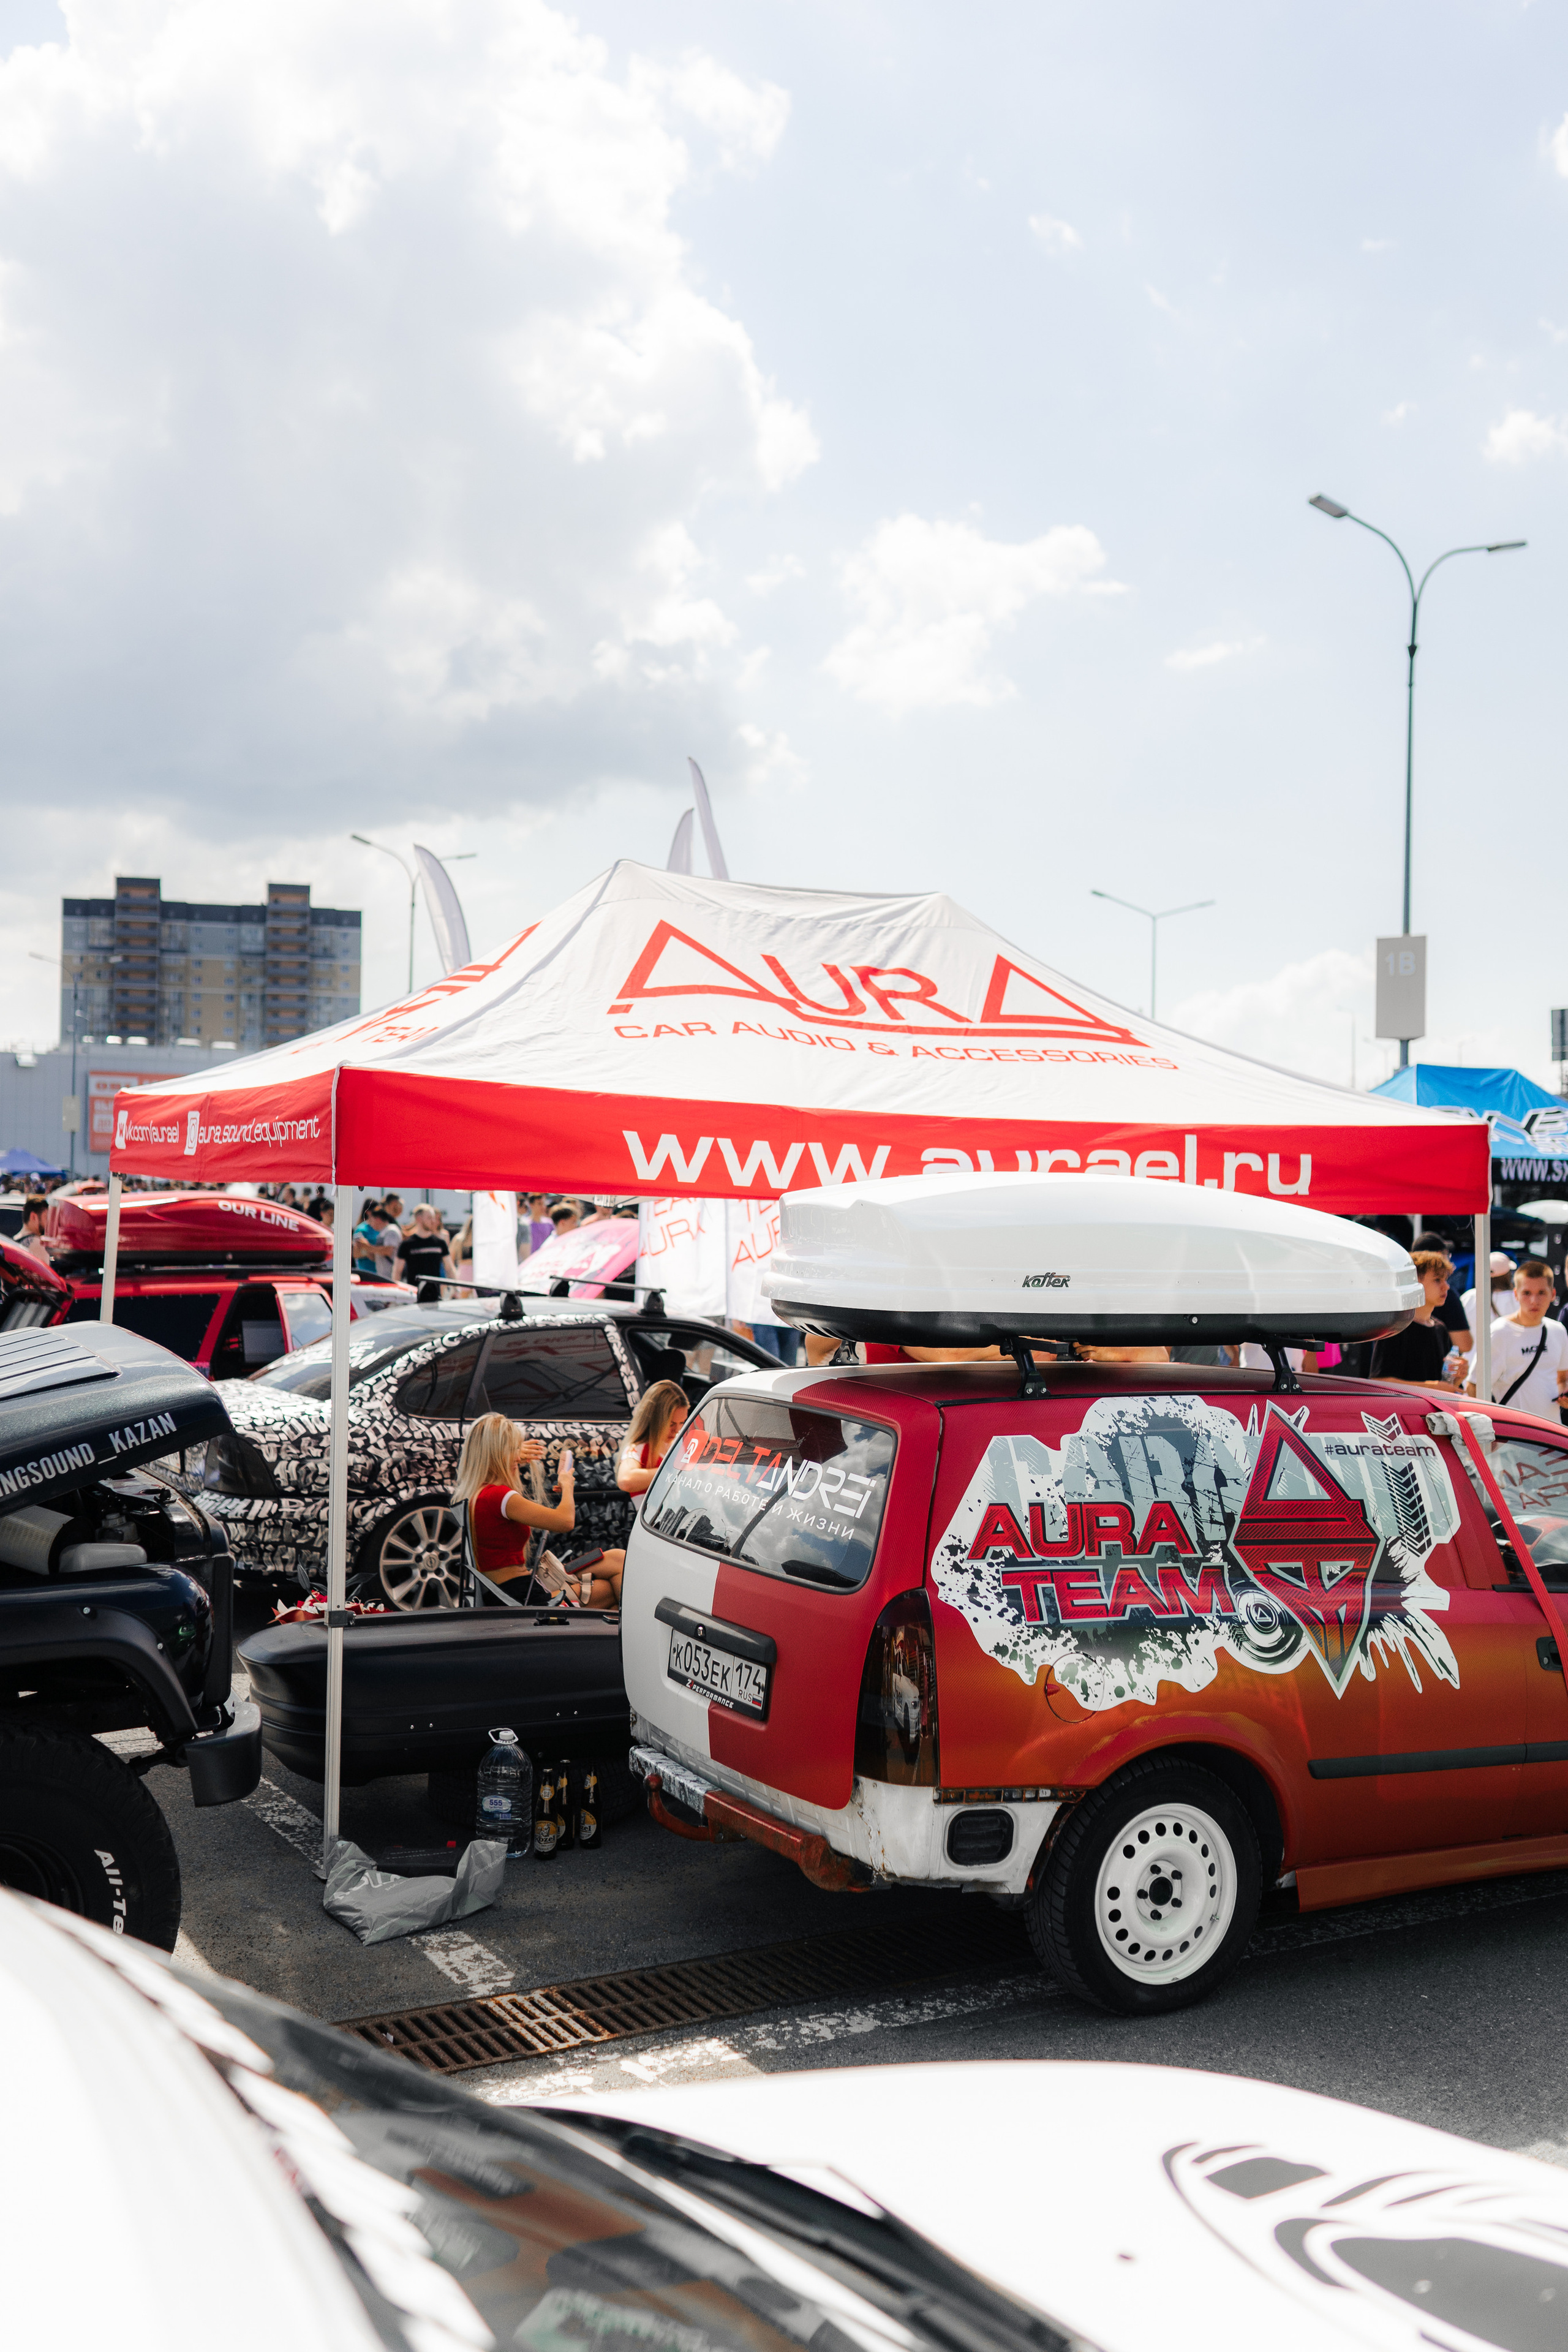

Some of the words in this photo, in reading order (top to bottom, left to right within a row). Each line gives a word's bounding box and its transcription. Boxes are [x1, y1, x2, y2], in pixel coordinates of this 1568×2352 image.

[607, 919, 1152, 1048] AURA
[614, 1022, 717, 1038] CAR
[733, 1021, 856, 1050] AUDIO
[867, 1042, 899, 1056] &
[913, 1046, 1179, 1069] ACCESSORIES
[198, 1115, 320, 1147] aura_sound_equipment
[622, 1130, 1311, 1195] wwwaurael.ru
[218, 1200, 257, 1219] OUR
[260, 1210, 300, 1232] LINE
[0, 1412, 177, 1497] NGSOUND_KAZAN
[1325, 1443, 1436, 1457] #aurateam
[665, 1473, 703, 1491] КАНАЛ
[715, 1485, 769, 1512] РАБОТЕ
[771, 1504, 783, 1516] И
[786, 1507, 855, 1540] ЖИЗНИ
[966, 1501, 1200, 1561] AURA
[1000, 1562, 1238, 1625] TEAM
[692, 1684, 734, 1708] PERFORMANCE
[736, 1662, 761, 1695] 174
[738, 1689, 752, 1702] RUS
